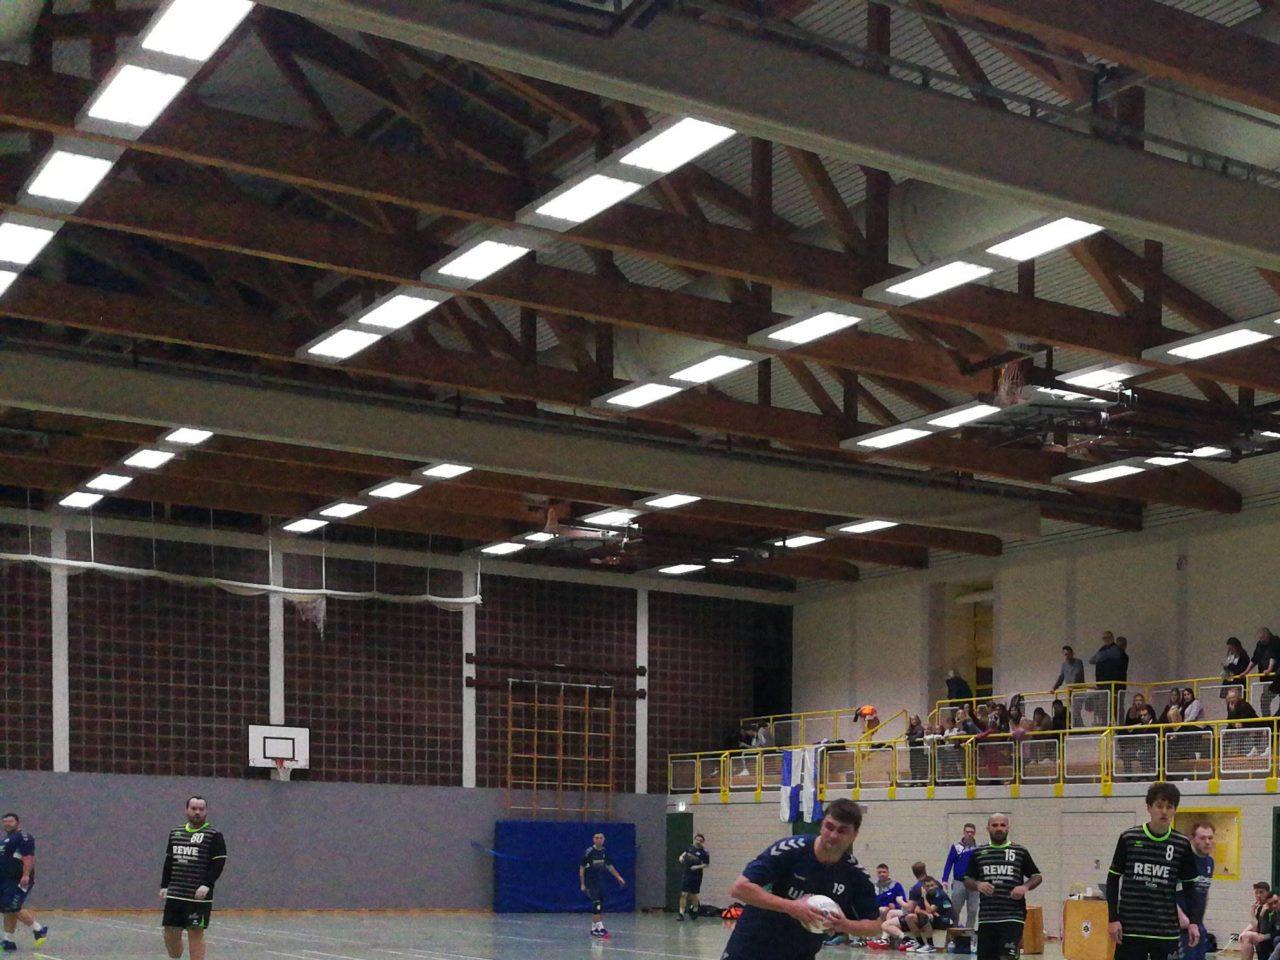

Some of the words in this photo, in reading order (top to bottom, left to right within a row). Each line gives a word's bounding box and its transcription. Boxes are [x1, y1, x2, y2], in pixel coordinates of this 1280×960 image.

[172, 845, 199, 856] REWE
[1005, 848, 1016, 862] 15
[1165, 844, 1175, 861] 8
[982, 864, 1015, 875] REWE
[1133, 862, 1171, 878] REWE
[832, 882, 846, 896] 19
